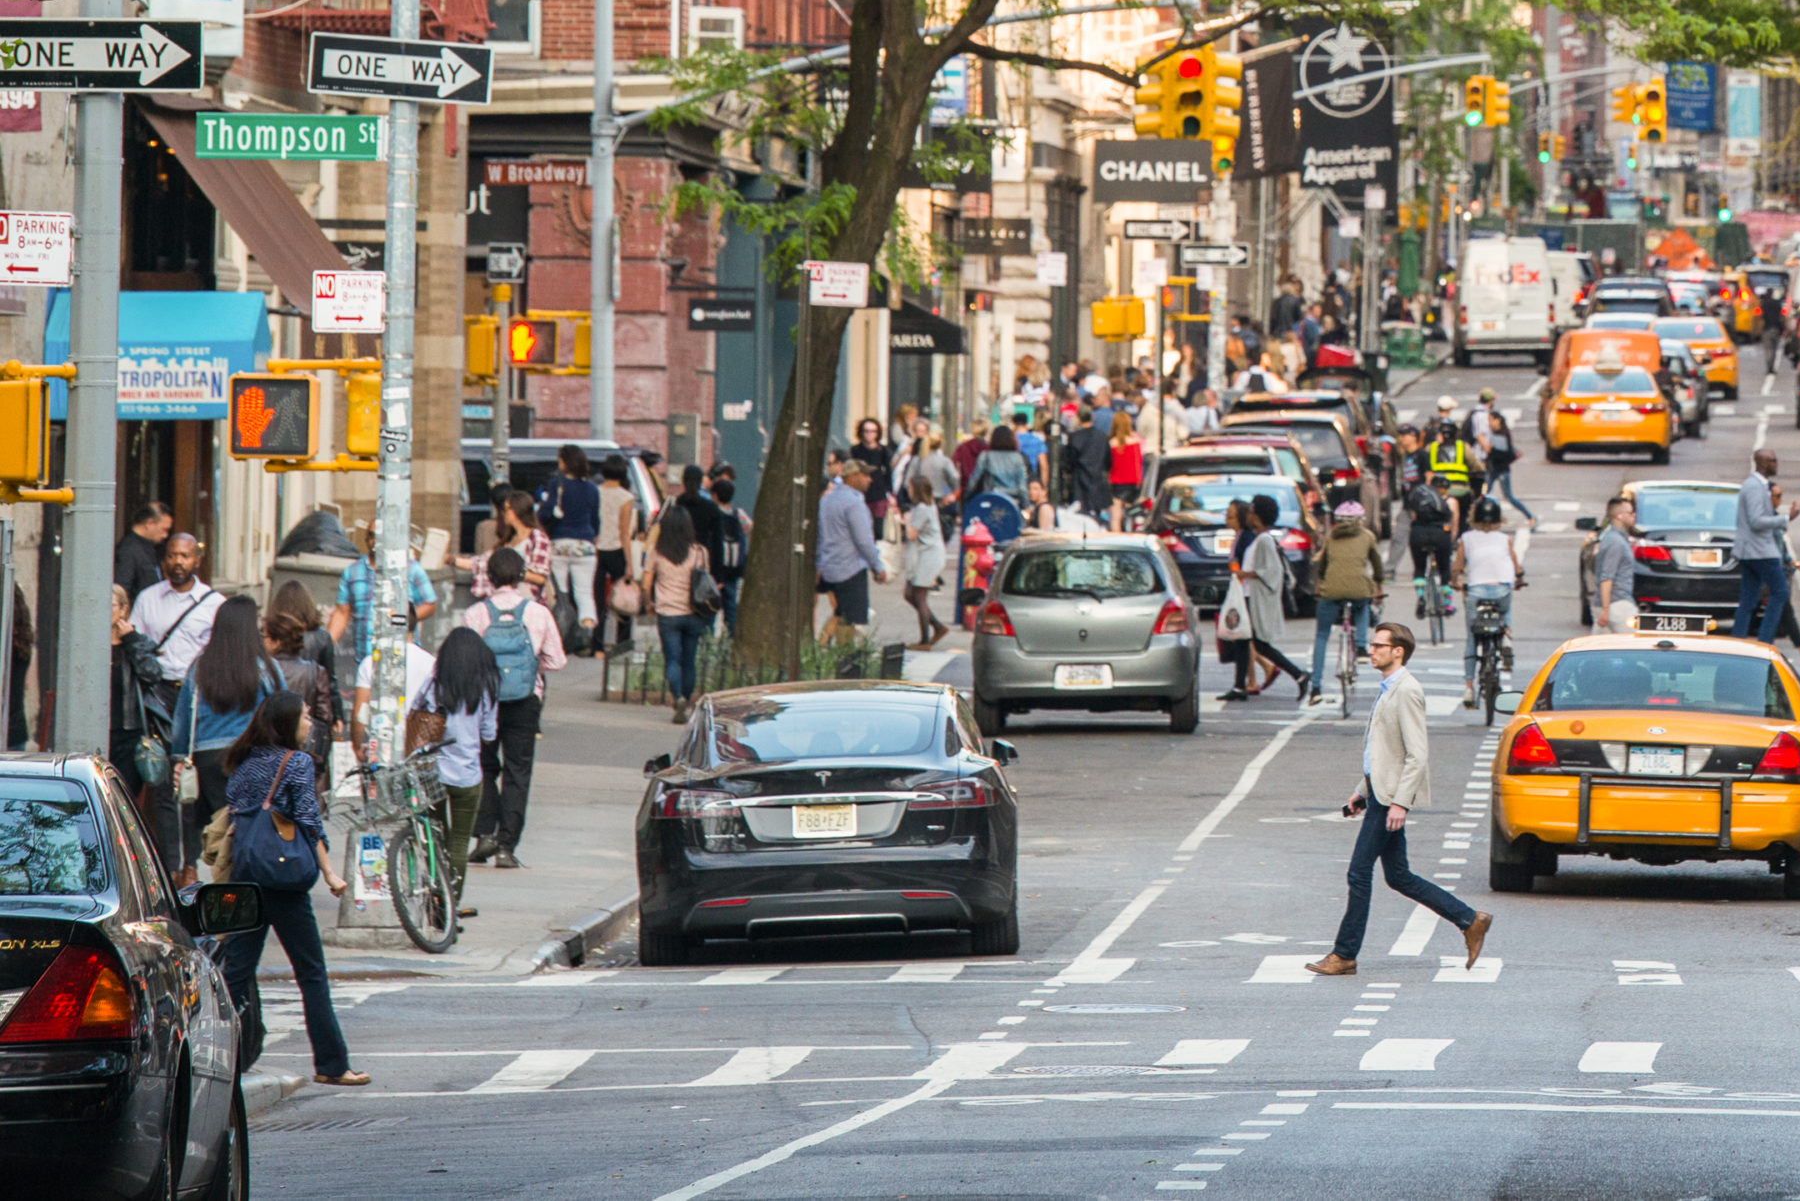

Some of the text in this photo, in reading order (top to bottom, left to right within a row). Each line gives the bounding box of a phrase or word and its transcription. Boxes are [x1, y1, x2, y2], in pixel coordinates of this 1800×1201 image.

[14, 42, 168, 68] ONE WAY
[337, 54, 463, 84] ONE WAY
[203, 119, 376, 159] Thompson St
[1303, 145, 1392, 166] American
[487, 164, 584, 185] W Broadway
[1099, 160, 1208, 182] CHANEL
[1303, 161, 1377, 185] Apparel
[16, 219, 66, 235] PARKING
[316, 276, 378, 297] NO PARKING
[175, 347, 211, 356] STREET
[120, 370, 223, 398] TROPOLITAN
[1655, 616, 1687, 631] 2L88
[362, 836, 382, 849] BE
[30, 939, 61, 949] XLS
